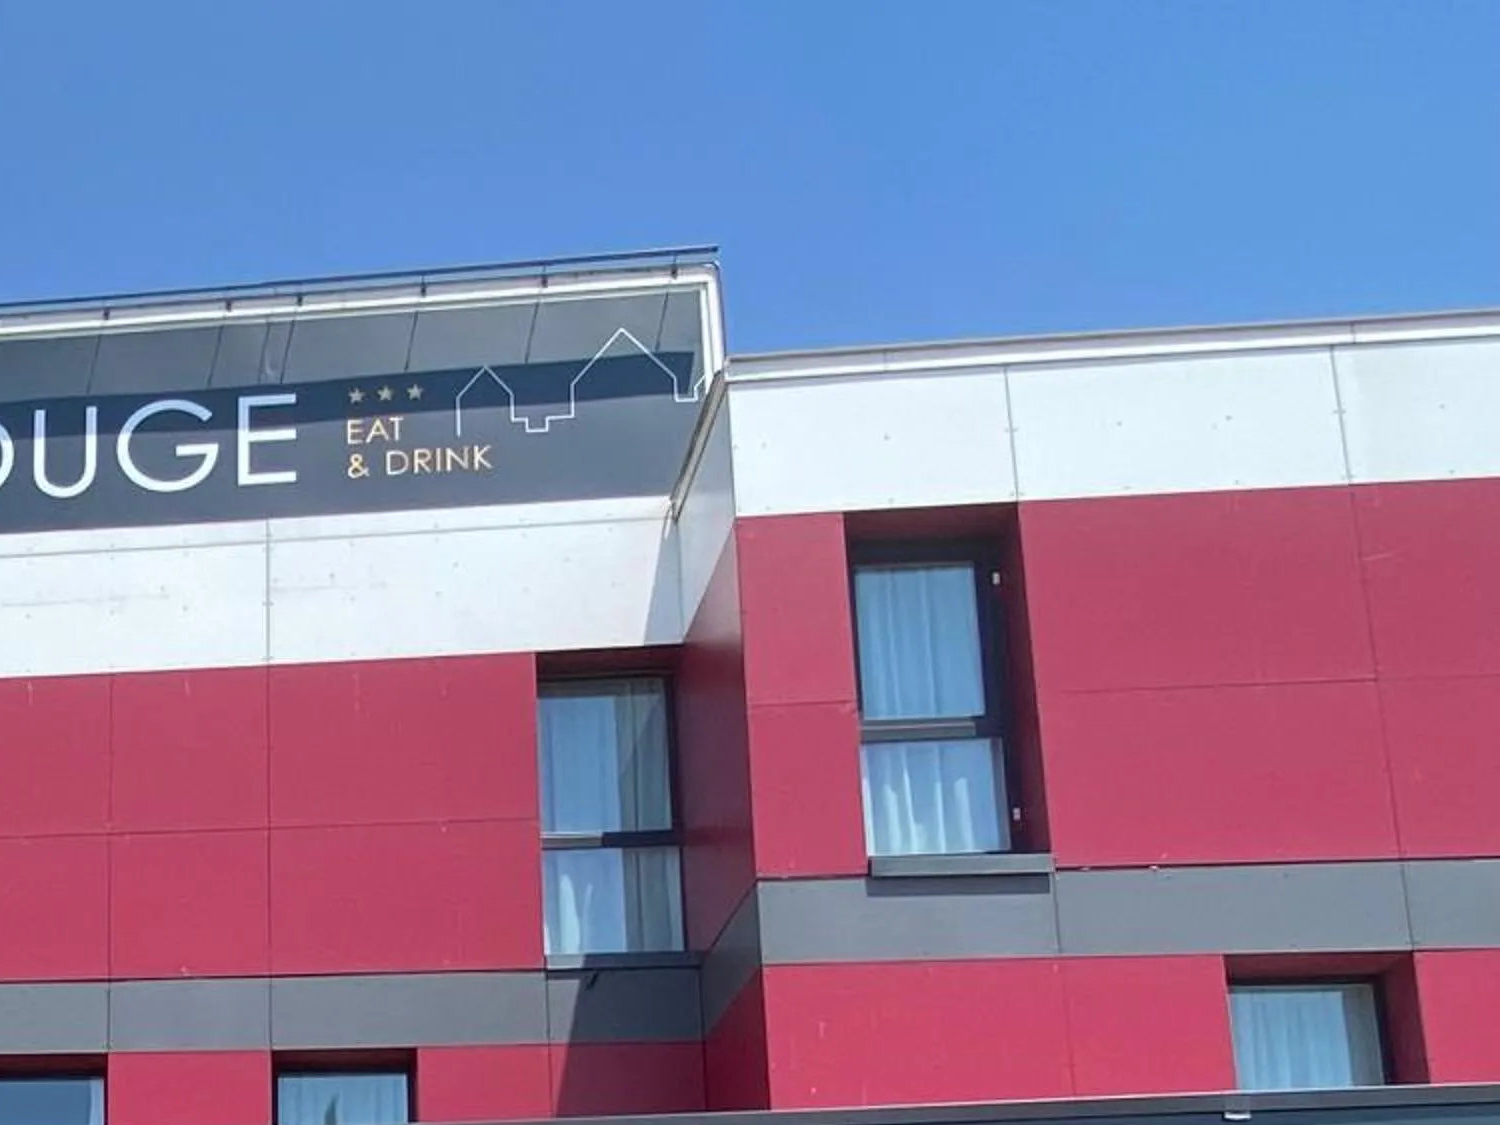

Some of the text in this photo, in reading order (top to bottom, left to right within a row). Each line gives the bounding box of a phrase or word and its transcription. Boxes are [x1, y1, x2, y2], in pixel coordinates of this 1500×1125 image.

[346, 416, 404, 445] EAT
[347, 445, 493, 479] & DRINK
